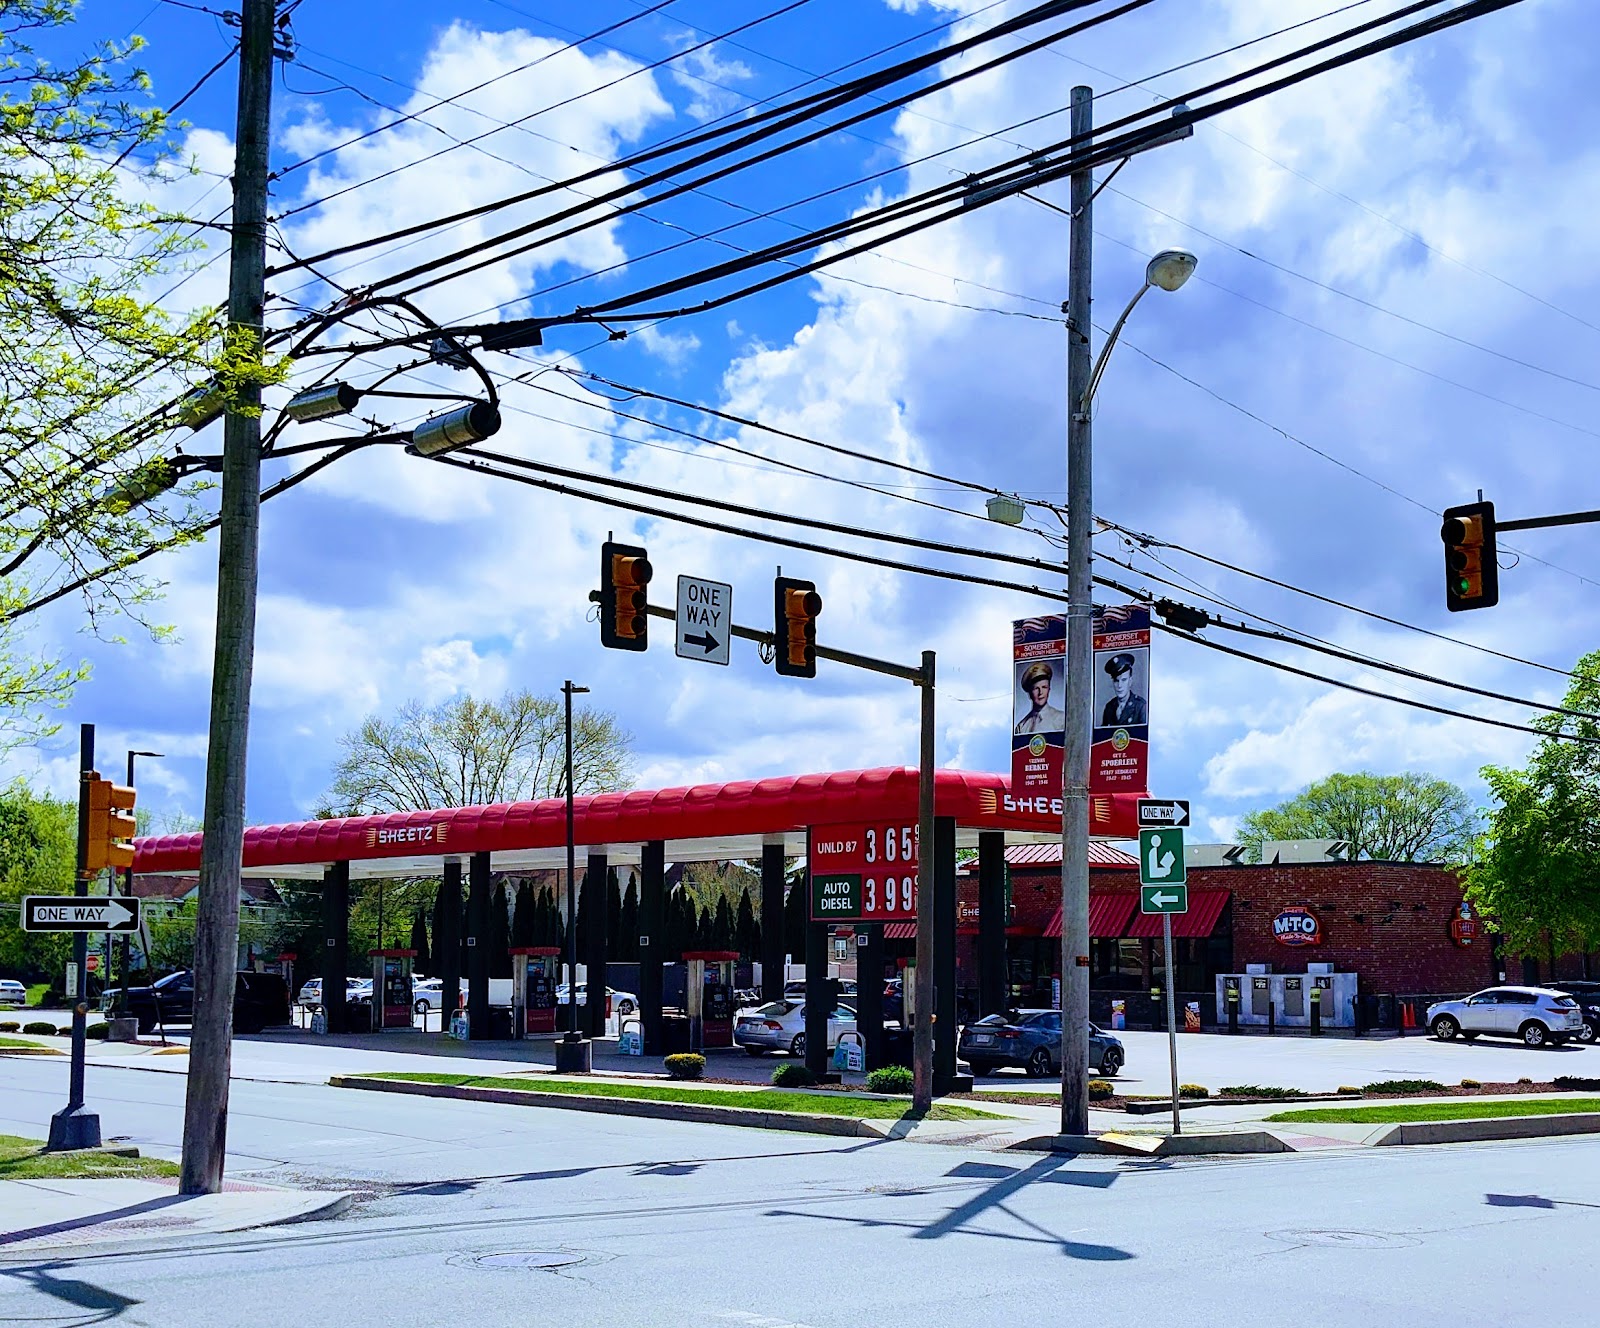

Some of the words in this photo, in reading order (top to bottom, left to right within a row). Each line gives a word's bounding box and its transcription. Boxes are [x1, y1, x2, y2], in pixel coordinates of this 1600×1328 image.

[688, 584, 721, 607] ONE
[686, 605, 722, 628] WAY
[1105, 632, 1139, 643] SOMERSET
[1023, 642, 1056, 652] SOMERSET
[1024, 763, 1050, 772] BERKEY
[1100, 758, 1138, 767] SPOERLEIN
[1003, 794, 1064, 815] SHEE
[1143, 807, 1158, 818] ONE
[1159, 807, 1175, 818] WAY
[378, 826, 433, 844] SHEETZ
[817, 841, 844, 855] UNLD
[845, 840, 857, 853] 87
[823, 881, 851, 895] AUTO
[821, 897, 853, 911] DIESEL
[37, 907, 68, 921] ONE
[74, 907, 105, 921] WAY
